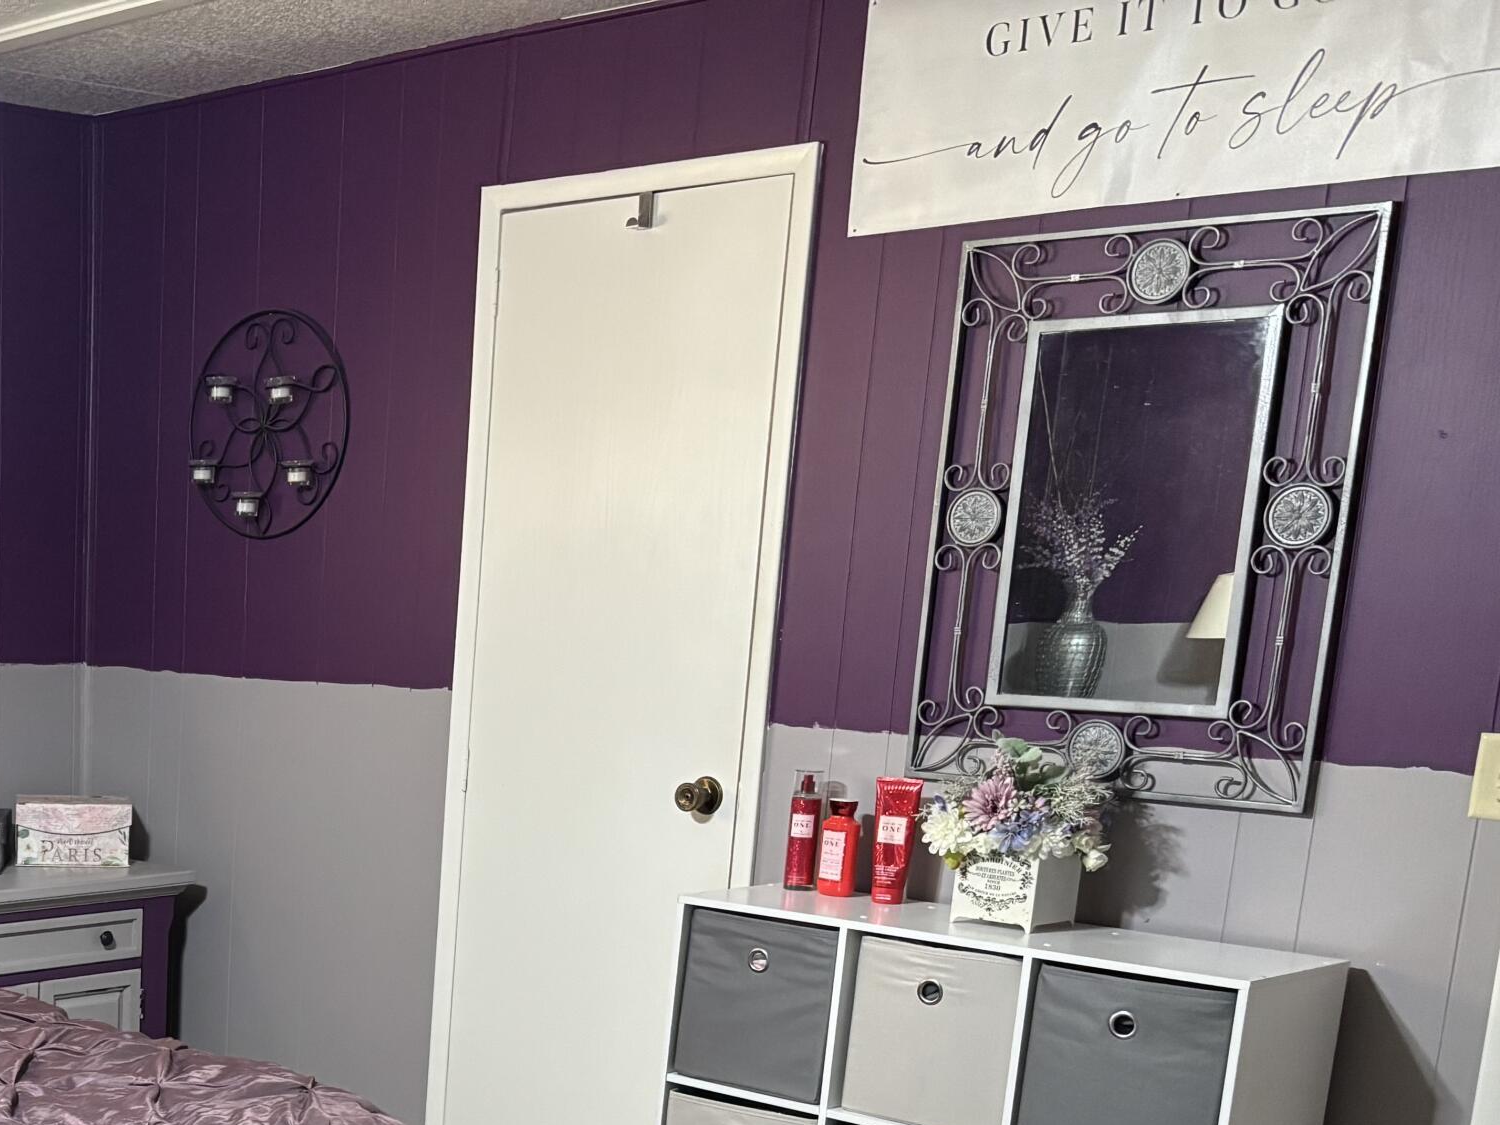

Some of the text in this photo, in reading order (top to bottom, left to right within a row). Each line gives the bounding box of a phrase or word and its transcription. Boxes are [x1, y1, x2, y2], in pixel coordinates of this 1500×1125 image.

[985, 7, 1094, 57] GIVE
[1117, 0, 1165, 36] IT
[1051, 122, 1150, 198] go
[1151, 65, 1256, 159] to
[1228, 48, 1500, 160] sleep
[41, 840, 102, 862] PARIS
[824, 839, 839, 847] ONE
